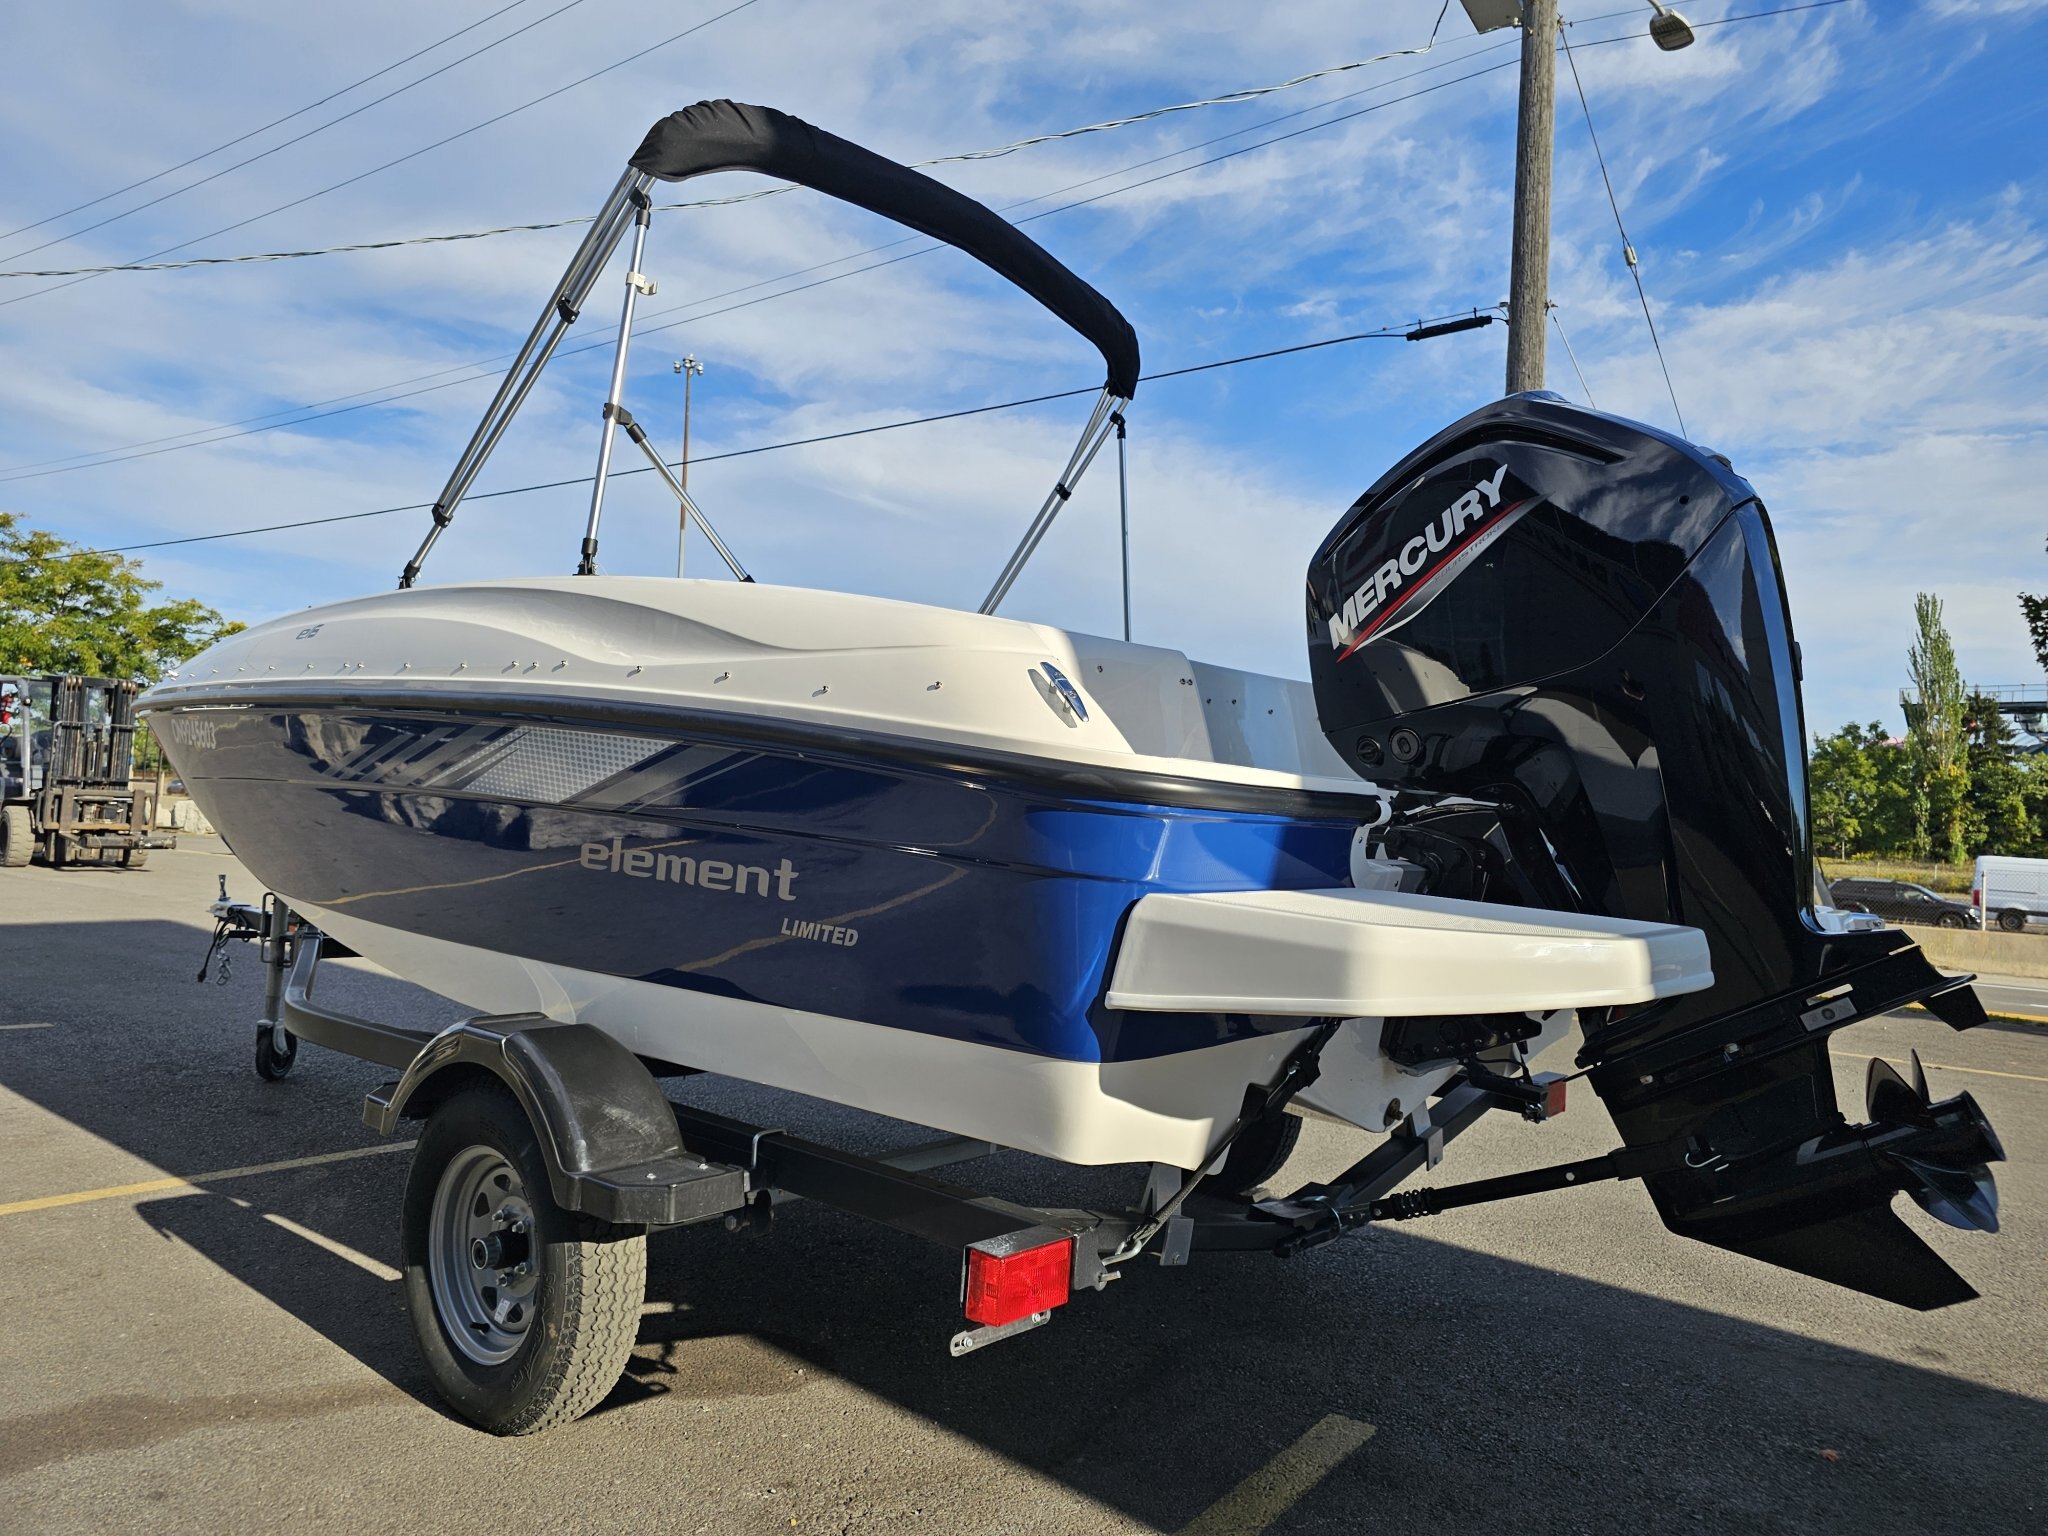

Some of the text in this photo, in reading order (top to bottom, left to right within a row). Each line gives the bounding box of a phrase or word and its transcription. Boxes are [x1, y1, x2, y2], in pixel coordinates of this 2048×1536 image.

[1328, 464, 1508, 650] MERCURY
[1432, 521, 1504, 584] FOURSTROKE
[580, 836, 800, 901] element
[780, 917, 859, 948] LIMITED
